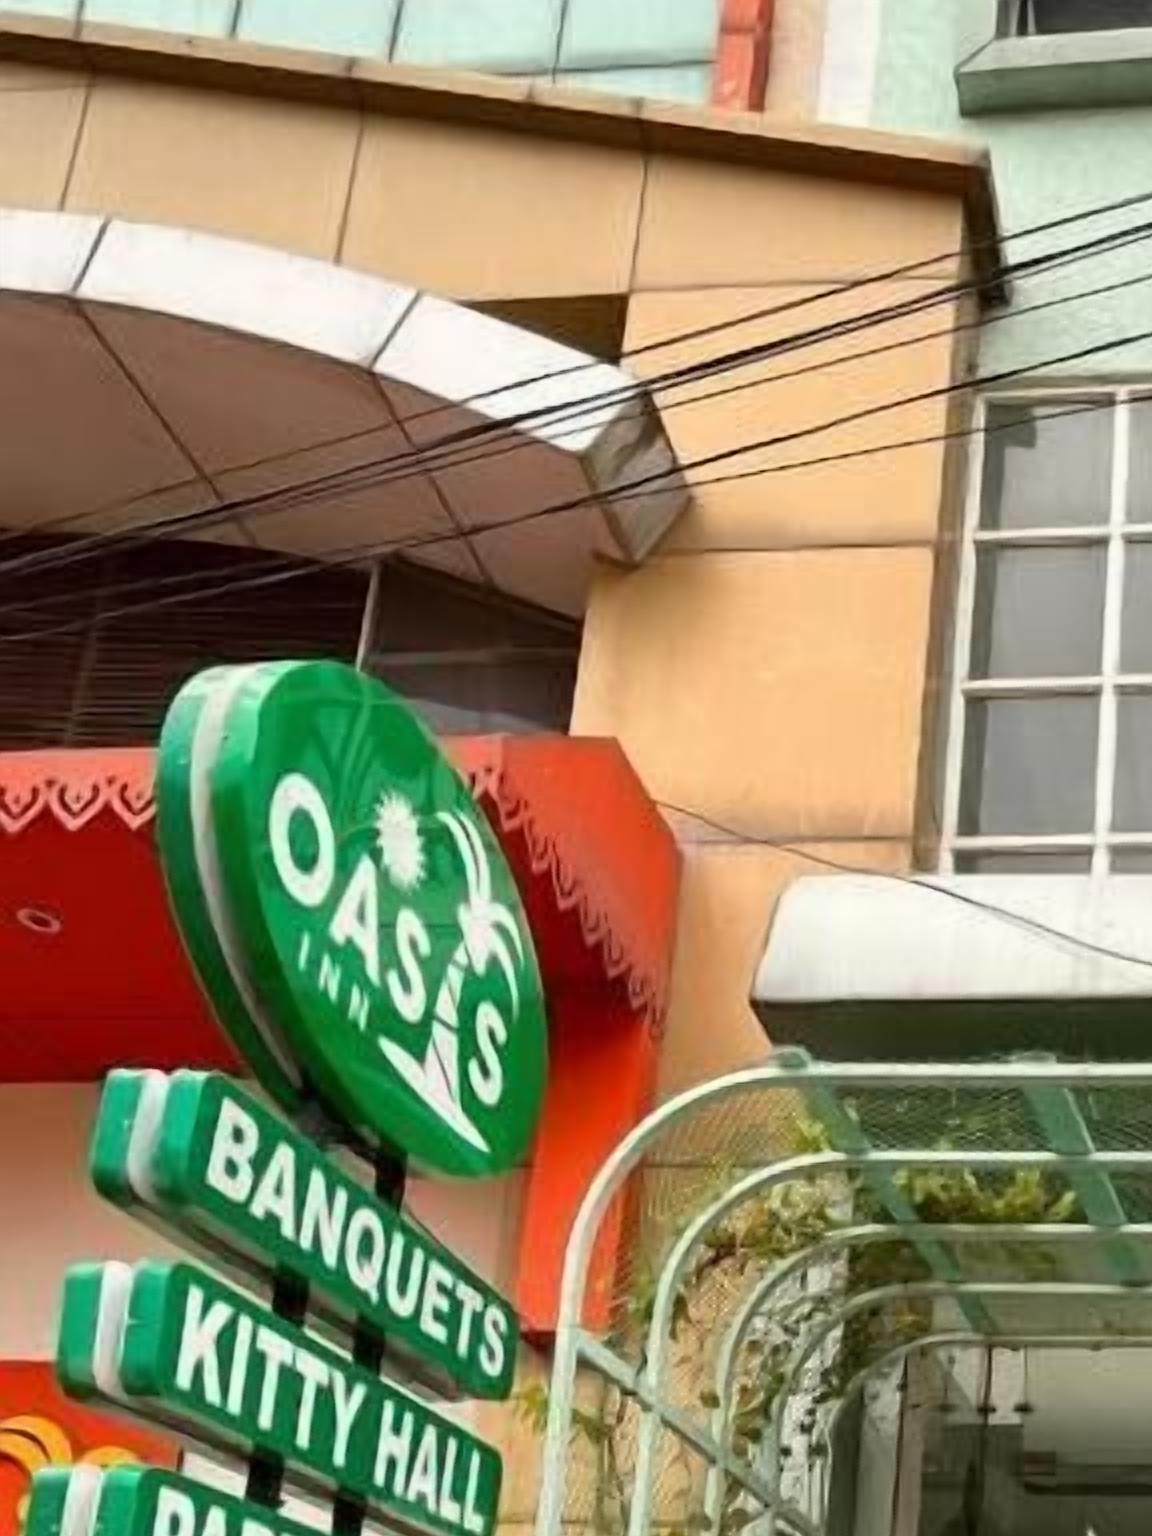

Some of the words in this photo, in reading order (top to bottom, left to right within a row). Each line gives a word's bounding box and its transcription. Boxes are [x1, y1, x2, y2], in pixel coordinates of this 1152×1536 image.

[299, 931, 369, 1031] INN
[206, 1096, 506, 1377] BANQUETS
[176, 1286, 366, 1468] KITTY
[375, 1400, 485, 1533] HALL
